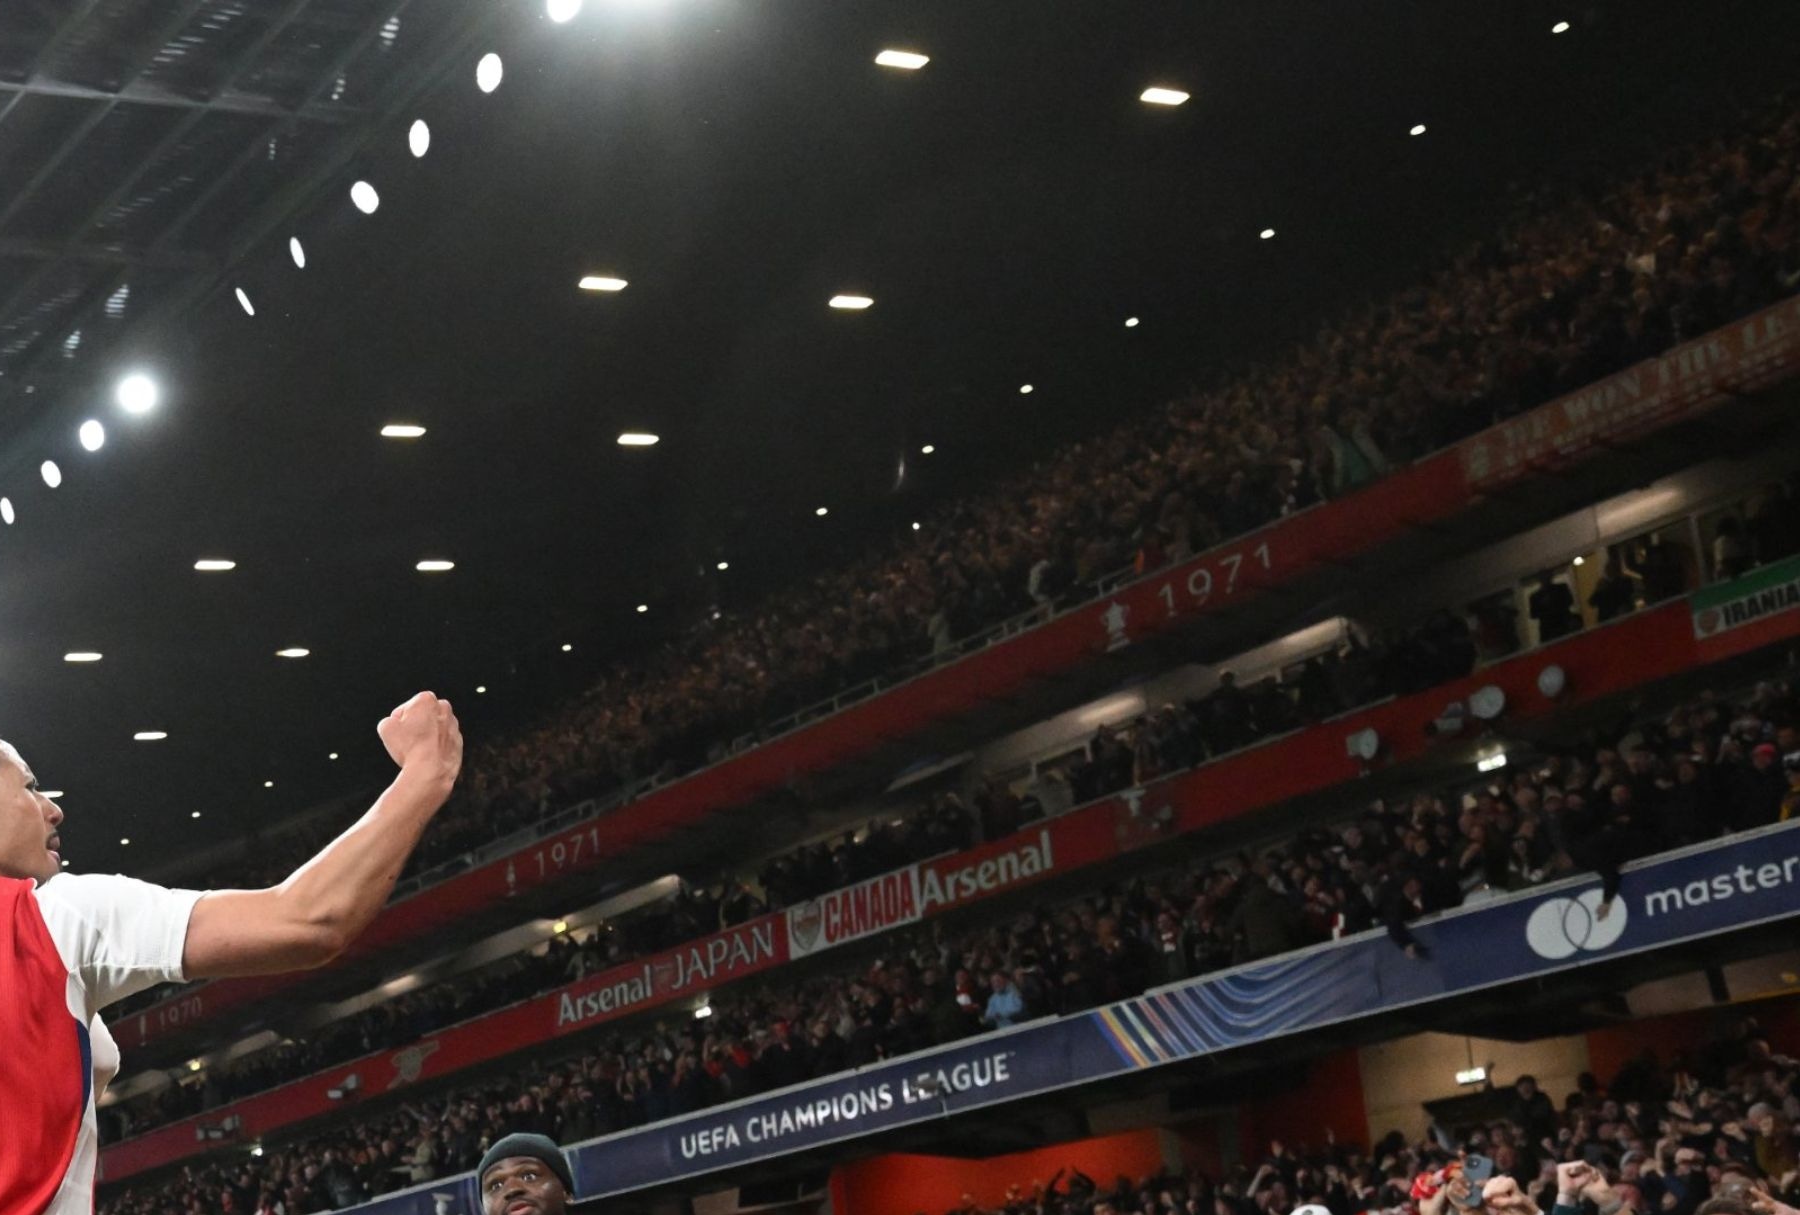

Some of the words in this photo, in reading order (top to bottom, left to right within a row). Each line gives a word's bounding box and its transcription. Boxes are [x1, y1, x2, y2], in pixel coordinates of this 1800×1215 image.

[1158, 541, 1273, 619] 1971
[533, 827, 600, 878] 1971
[920, 829, 1055, 908] Arsenal
[823, 869, 917, 944] CANADA
[558, 964, 653, 1026] Arsenal
[672, 922, 774, 990] JAPAN
[680, 1124, 741, 1160] UEFA
[746, 1083, 894, 1144] CHAMPIONS
[902, 1053, 1010, 1105] LEAGUE
